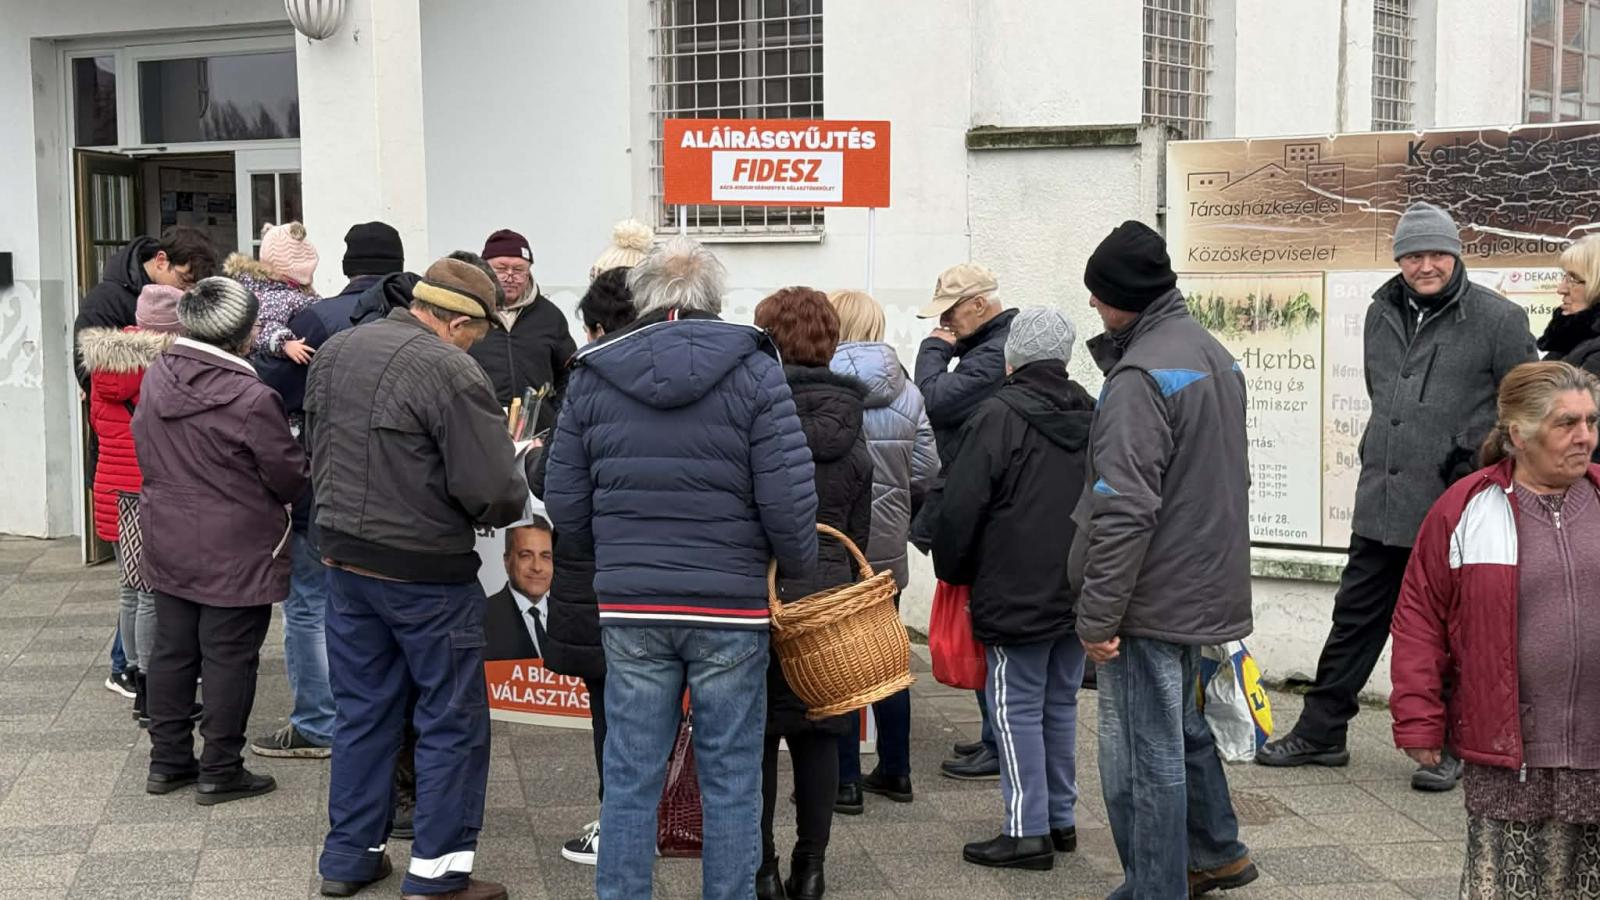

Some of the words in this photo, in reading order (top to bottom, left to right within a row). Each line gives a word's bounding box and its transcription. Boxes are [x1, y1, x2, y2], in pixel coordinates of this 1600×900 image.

[681, 126, 876, 149] ALÁÍRÁSGYŰJTÉS
[732, 158, 822, 182] FIDESZ
[1190, 199, 1338, 216] Társasházkezelés
[1188, 245, 1338, 264] Közösképviselet
[1287, 377, 1305, 392] és
[1253, 526, 1308, 538] üzletsoron
[511, 664, 524, 682] A
[490, 683, 590, 709] VÁLASZTÁS
